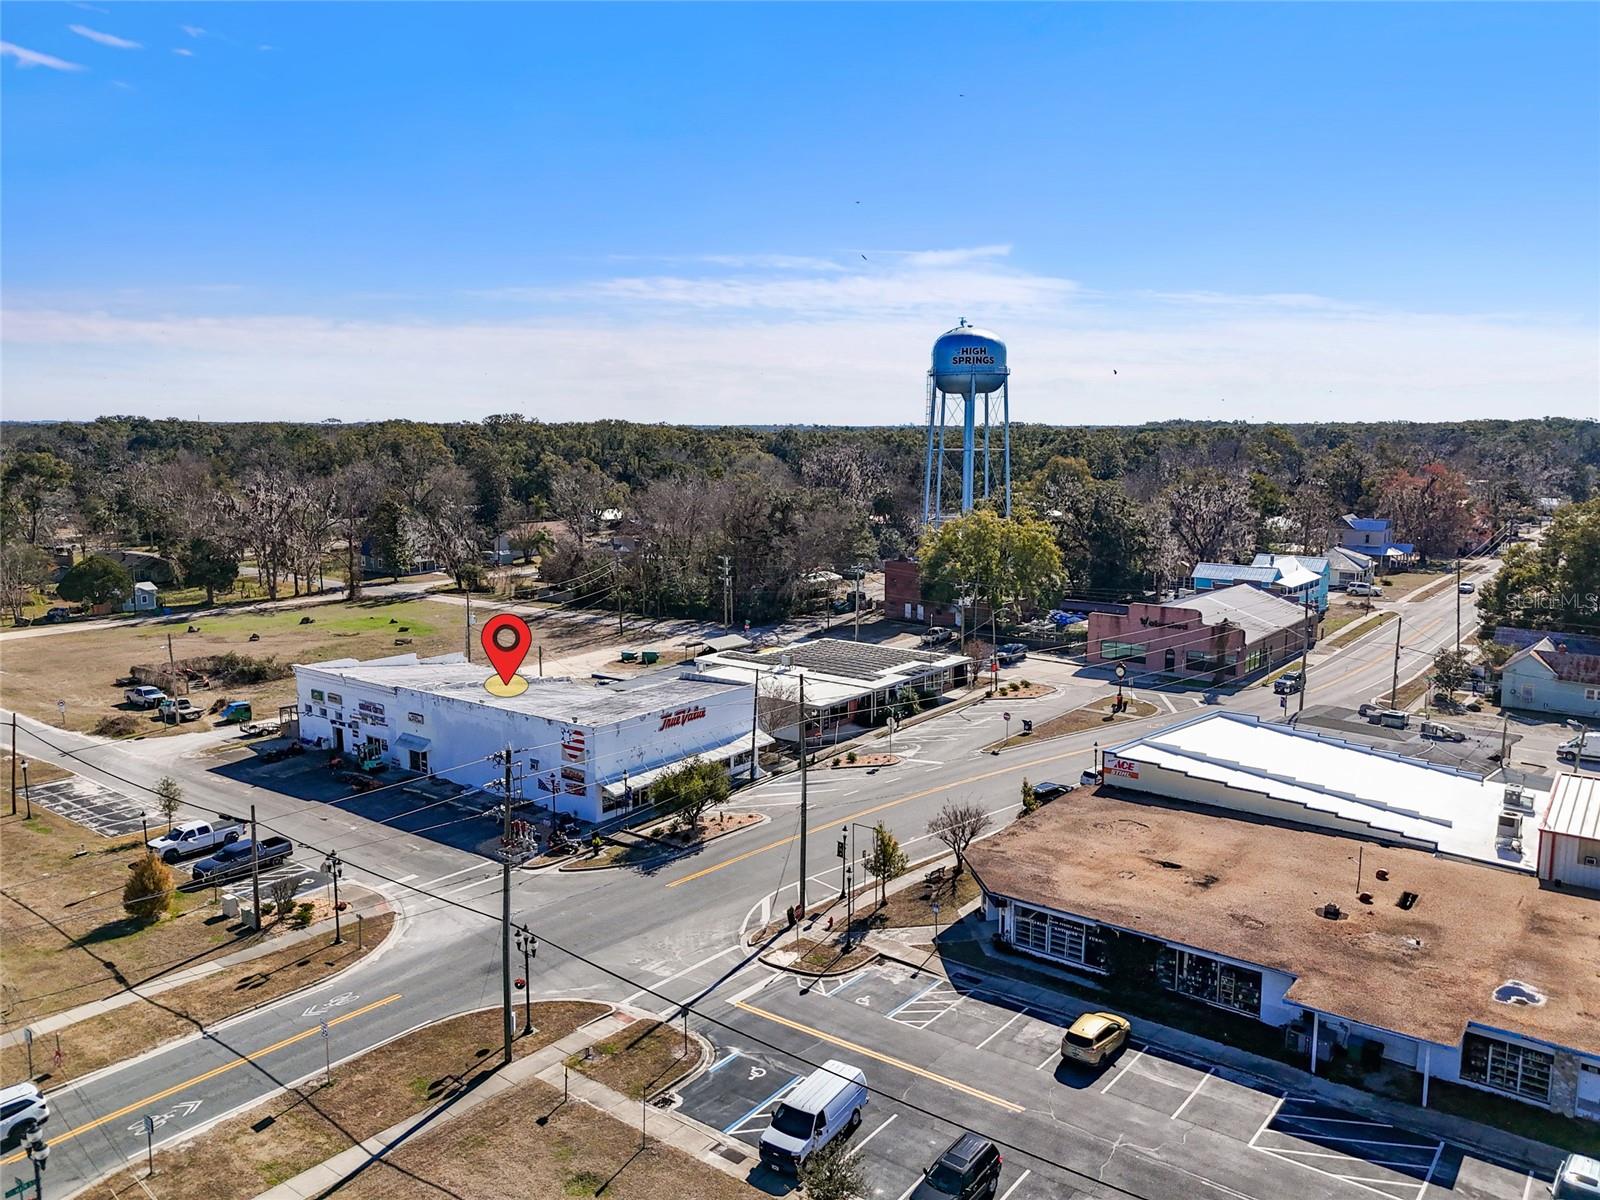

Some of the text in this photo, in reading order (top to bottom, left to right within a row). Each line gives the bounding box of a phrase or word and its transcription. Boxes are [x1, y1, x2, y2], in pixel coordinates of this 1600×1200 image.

[961, 347, 987, 355] HIGH
[952, 356, 995, 365] SPRINGS
[1113, 759, 1136, 771] ACE
